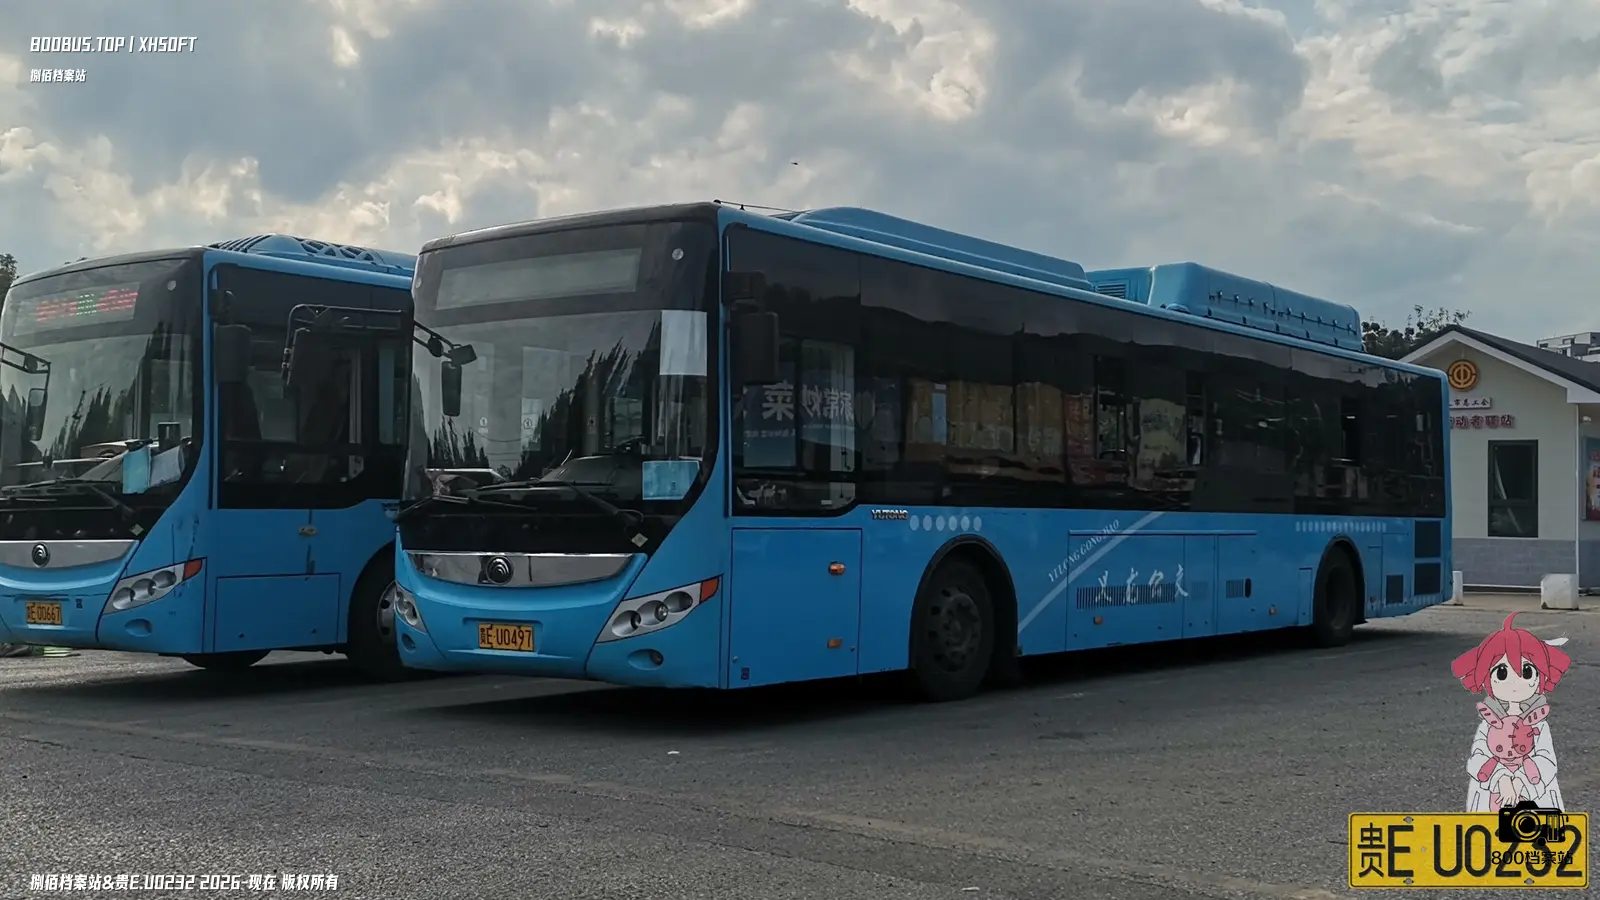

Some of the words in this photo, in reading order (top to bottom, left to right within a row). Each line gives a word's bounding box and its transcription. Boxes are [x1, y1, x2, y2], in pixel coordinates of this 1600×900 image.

[1449, 397, 1490, 407] 市总工会
[871, 508, 909, 520] YUTONG
